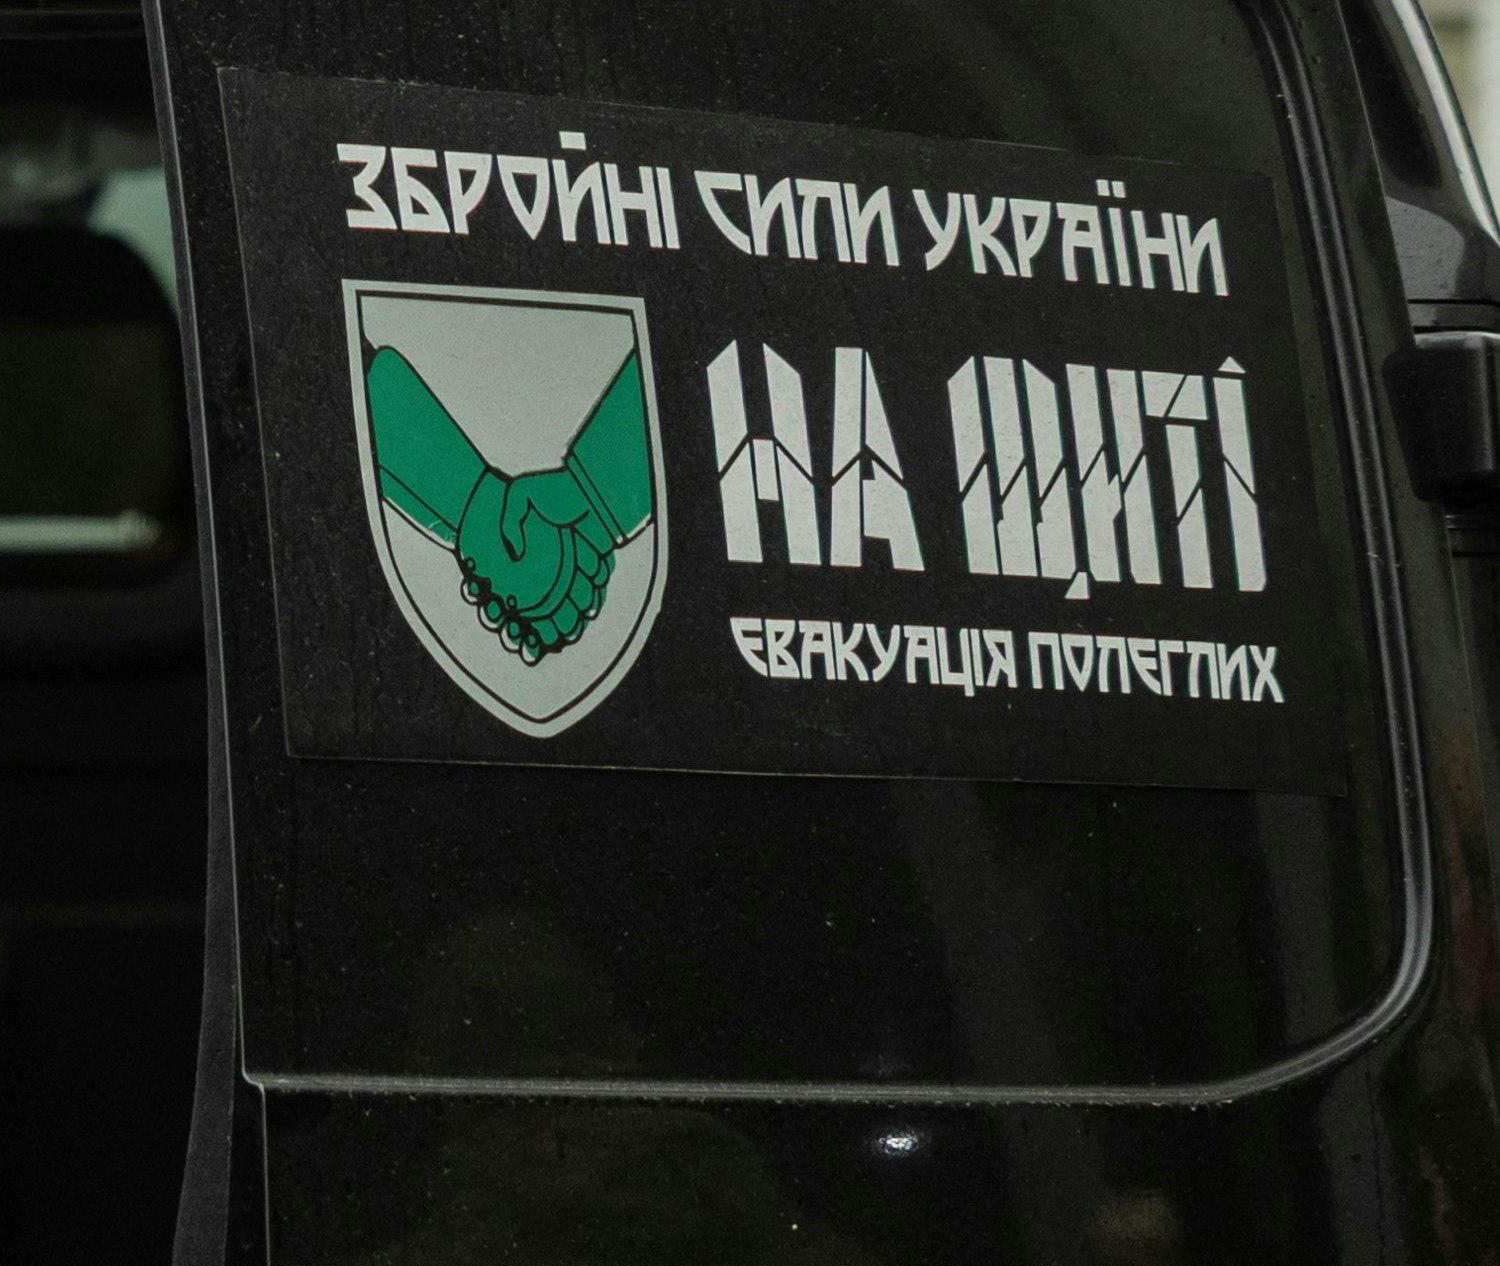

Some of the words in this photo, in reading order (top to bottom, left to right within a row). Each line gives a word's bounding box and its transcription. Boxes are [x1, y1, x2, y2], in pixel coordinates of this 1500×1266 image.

[336, 130, 681, 250] ЗБРОЙНІ
[693, 169, 900, 267] СИЛИ
[911, 178, 1229, 297] УКРАЇНИ
[706, 339, 925, 573] НА
[947, 355, 1267, 600] ЩИТІ
[729, 616, 1019, 698] ЄВАКУАЦІЯ
[1027, 631, 1285, 703] ПОЛЕГЛИХ
